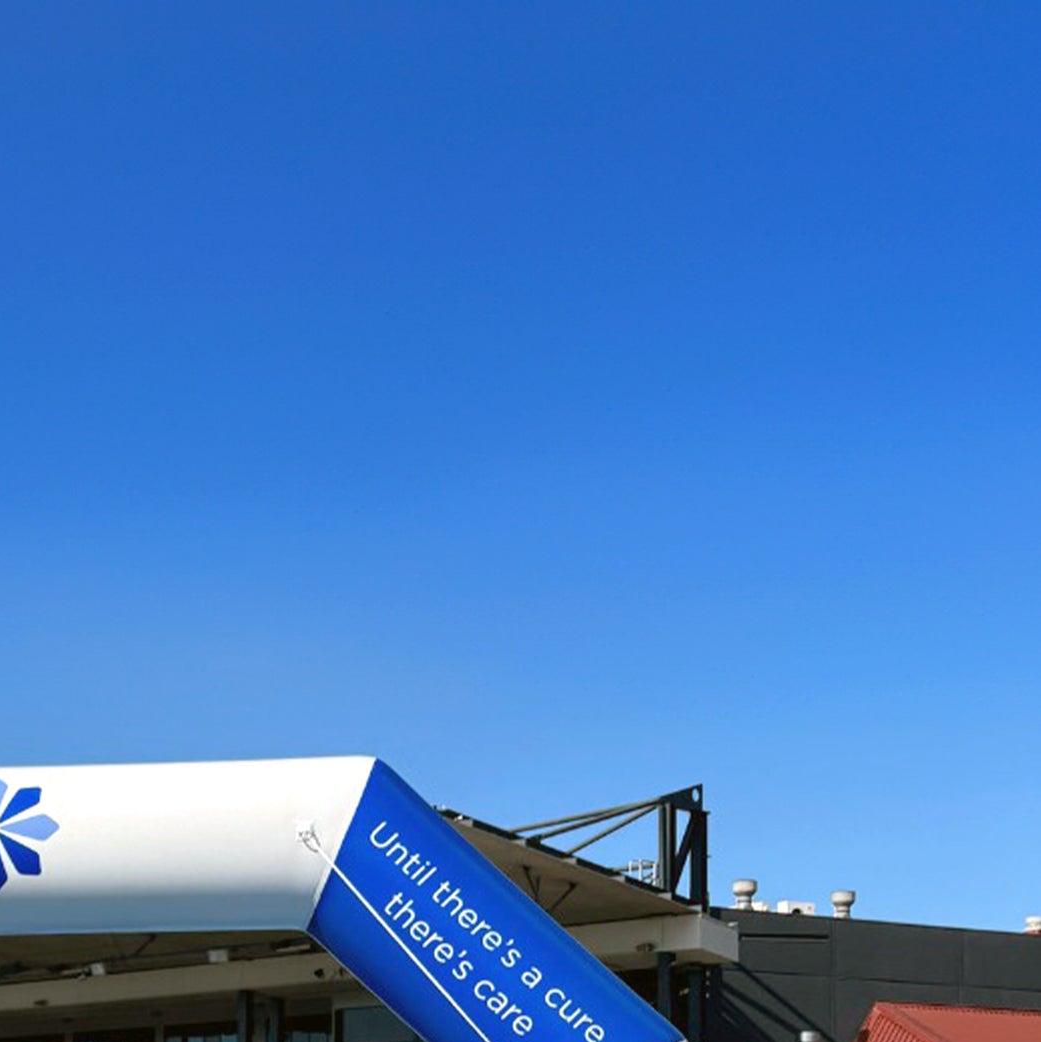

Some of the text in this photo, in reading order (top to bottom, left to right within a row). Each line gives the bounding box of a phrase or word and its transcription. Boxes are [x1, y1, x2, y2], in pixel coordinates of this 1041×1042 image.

[369, 821, 437, 887] Until
[432, 881, 521, 968] there's
[521, 966, 542, 989] a
[383, 892, 534, 1036] there's care
